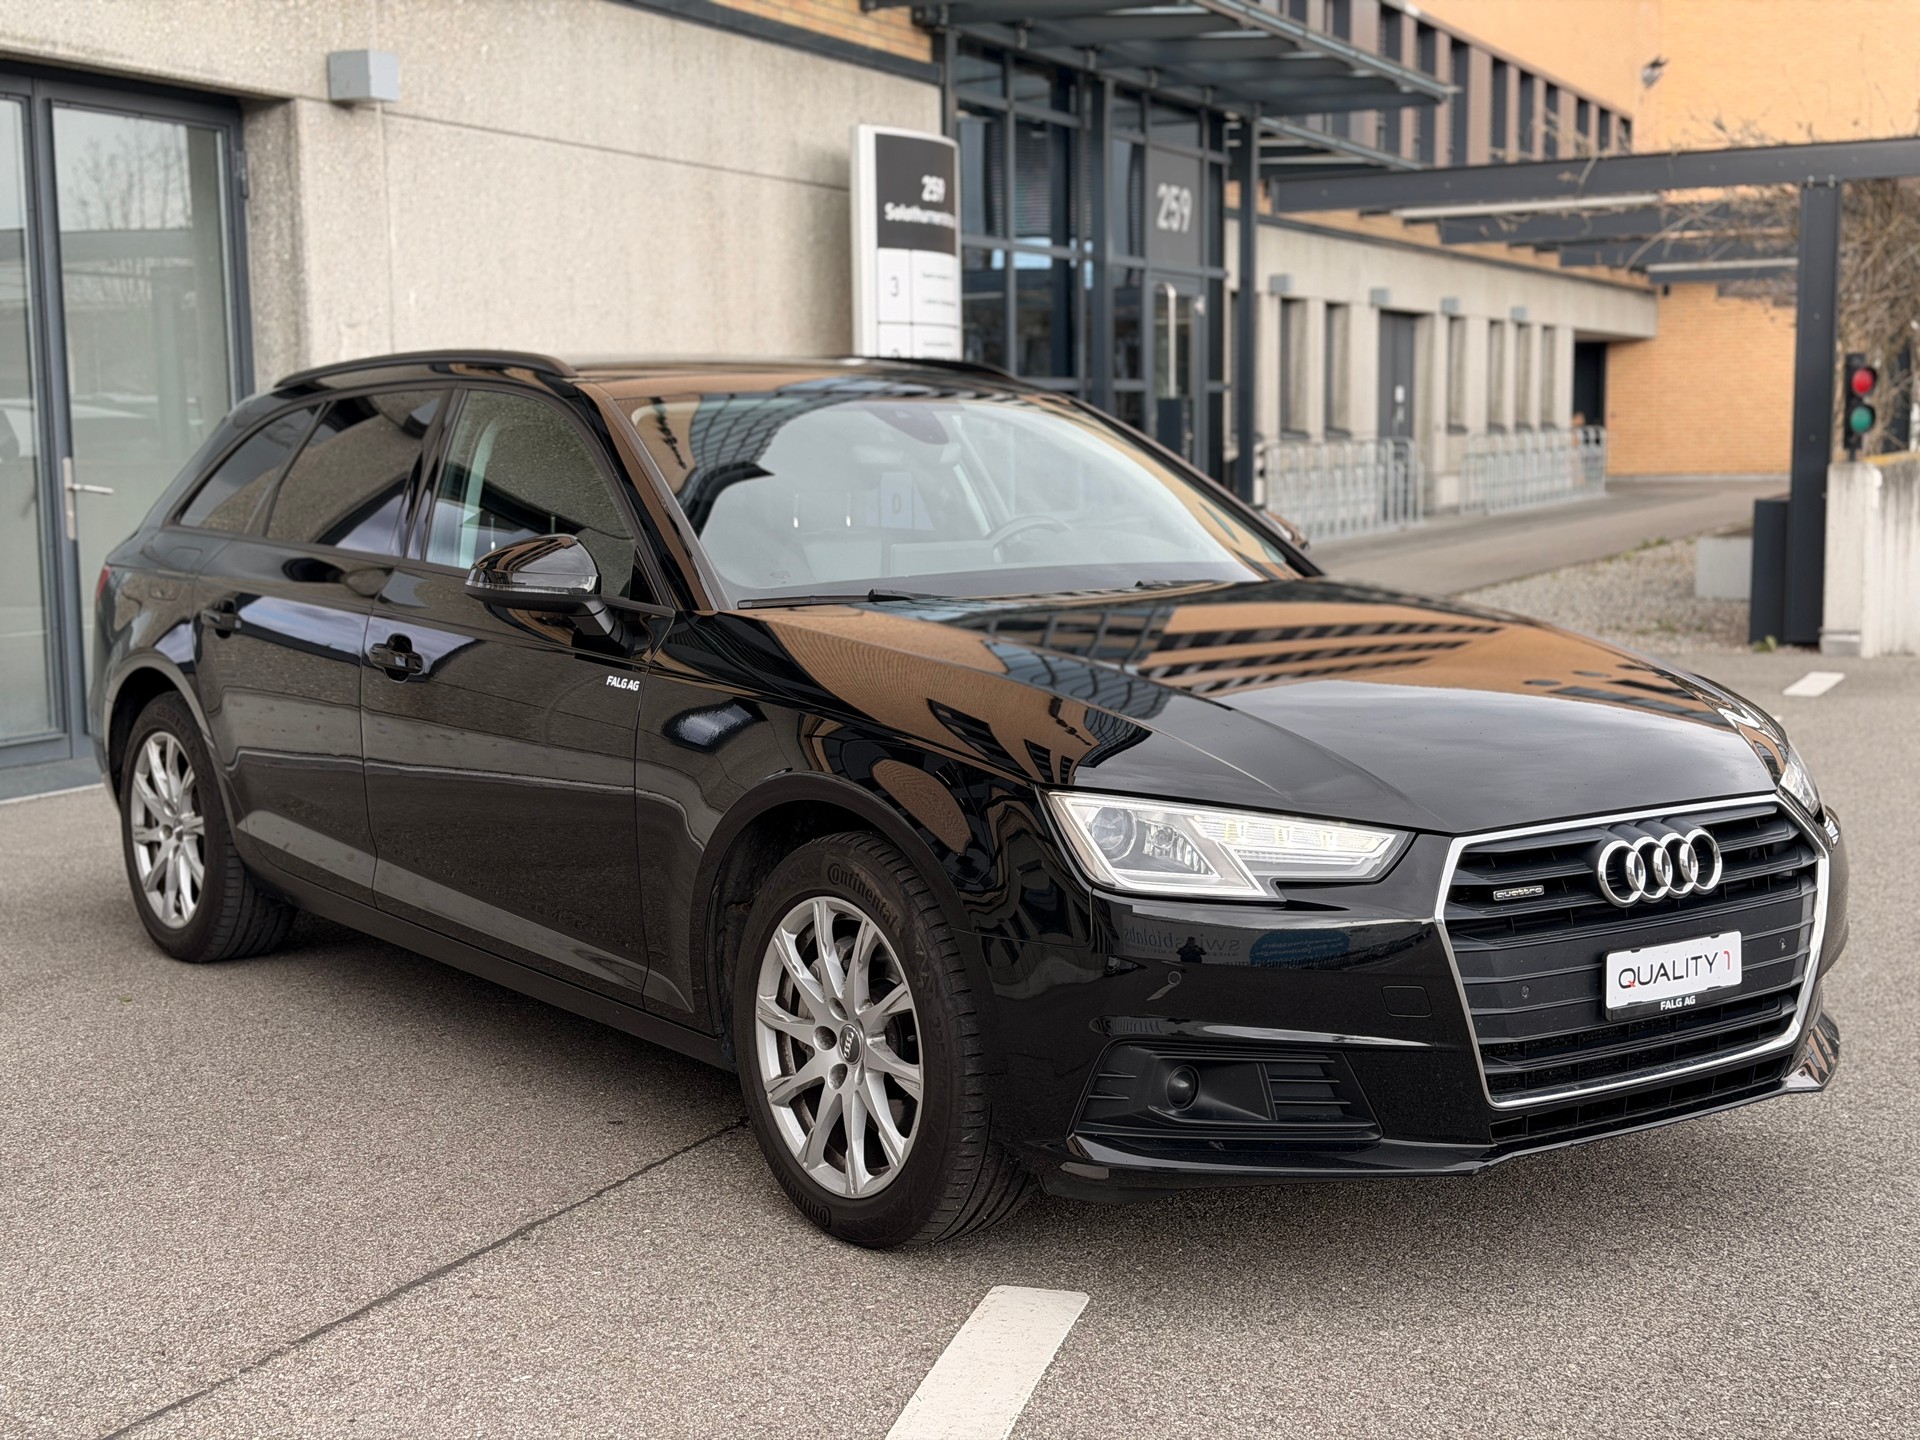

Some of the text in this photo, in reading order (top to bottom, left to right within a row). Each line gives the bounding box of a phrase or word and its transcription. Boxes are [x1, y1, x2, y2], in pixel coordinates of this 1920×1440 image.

[1156, 182, 1192, 233] 259
[607, 676, 640, 691] FALG AG
[827, 862, 898, 927] Continental
[1496, 887, 1542, 899] quattro
[1618, 950, 1731, 989] QUALITY 1
[1660, 995, 1696, 1011] FALG AG
